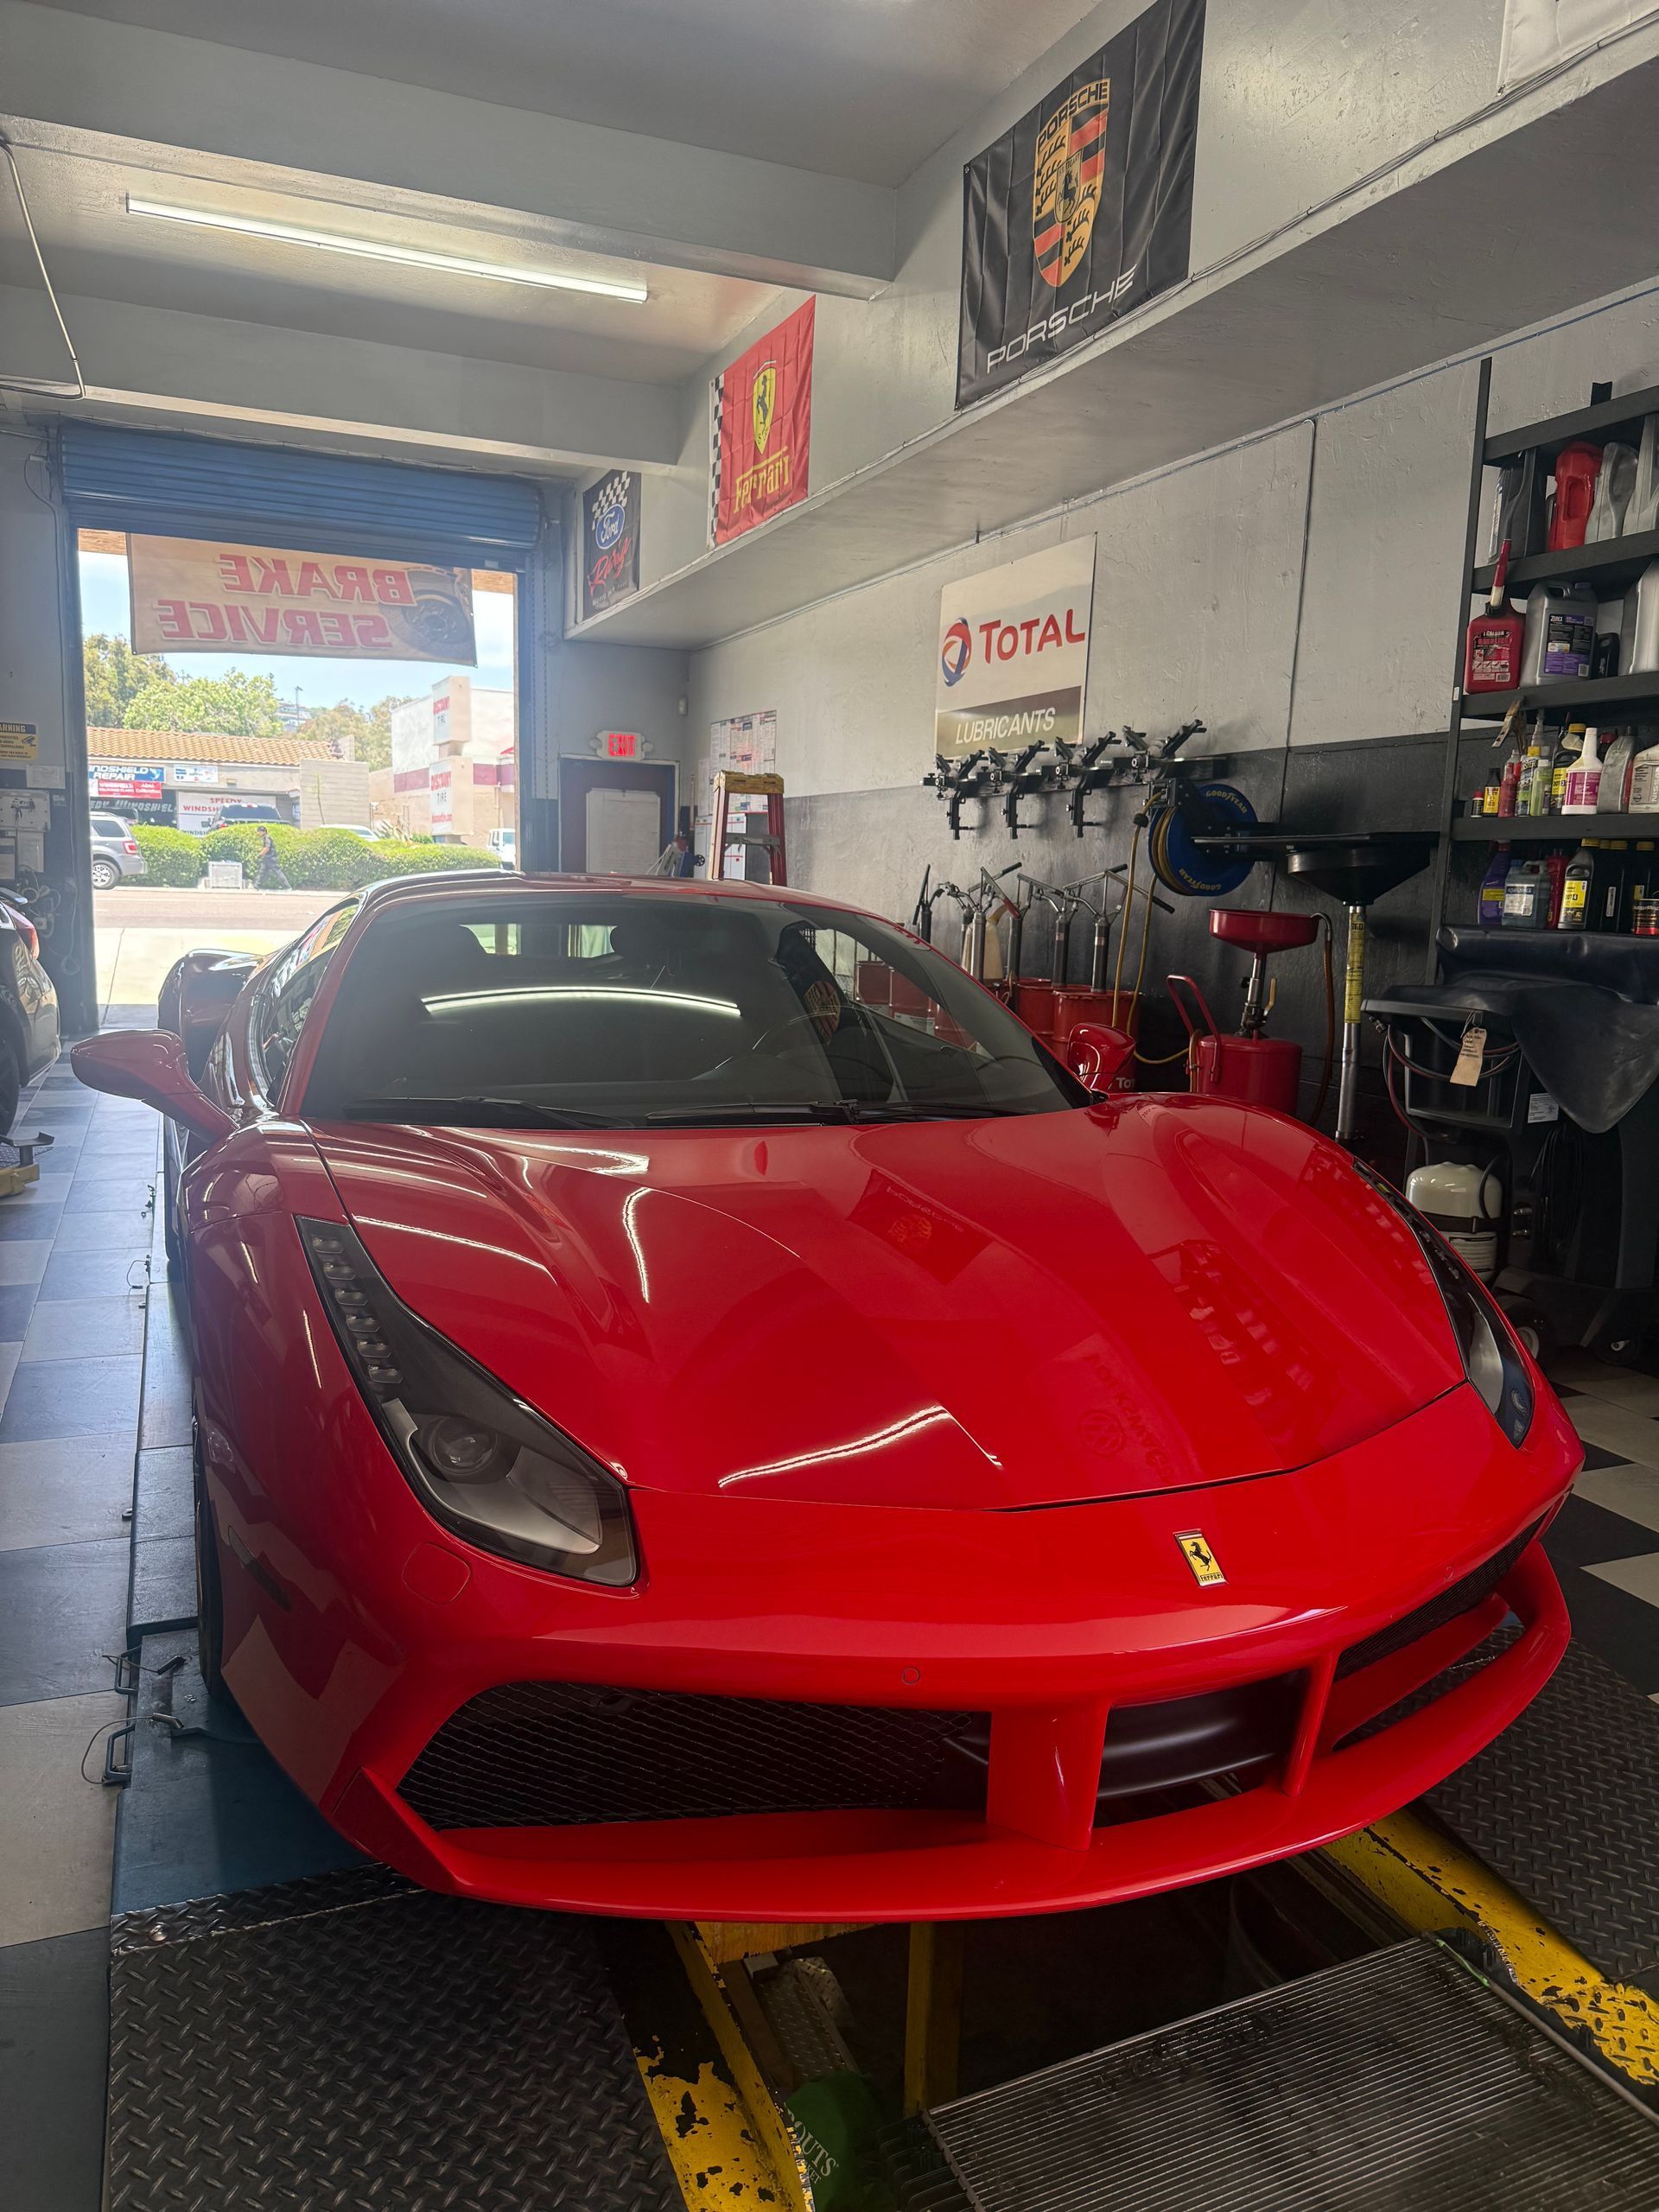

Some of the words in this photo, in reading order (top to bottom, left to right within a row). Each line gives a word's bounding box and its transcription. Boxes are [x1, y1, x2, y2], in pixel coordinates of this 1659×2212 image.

[1037, 80, 1109, 150] PORSCHE
[987, 263, 1138, 374] PORSCHE
[734, 445, 790, 513] Ferrari
[600, 511, 620, 541] Ford
[979, 608, 1086, 665] TOTAL
[956, 707, 1056, 746] LUBRICANTS
[608, 734, 636, 757] EXIT
[92, 772, 136, 781] REPAIR
[89, 799, 110, 810] EDY
[115, 799, 176, 812] WINDSHIEL
[1205, 790, 1248, 814] GOODYEAR
[1179, 868, 1221, 891] GOODYEAR
[1199, 1573, 1224, 1582] Ferrari
